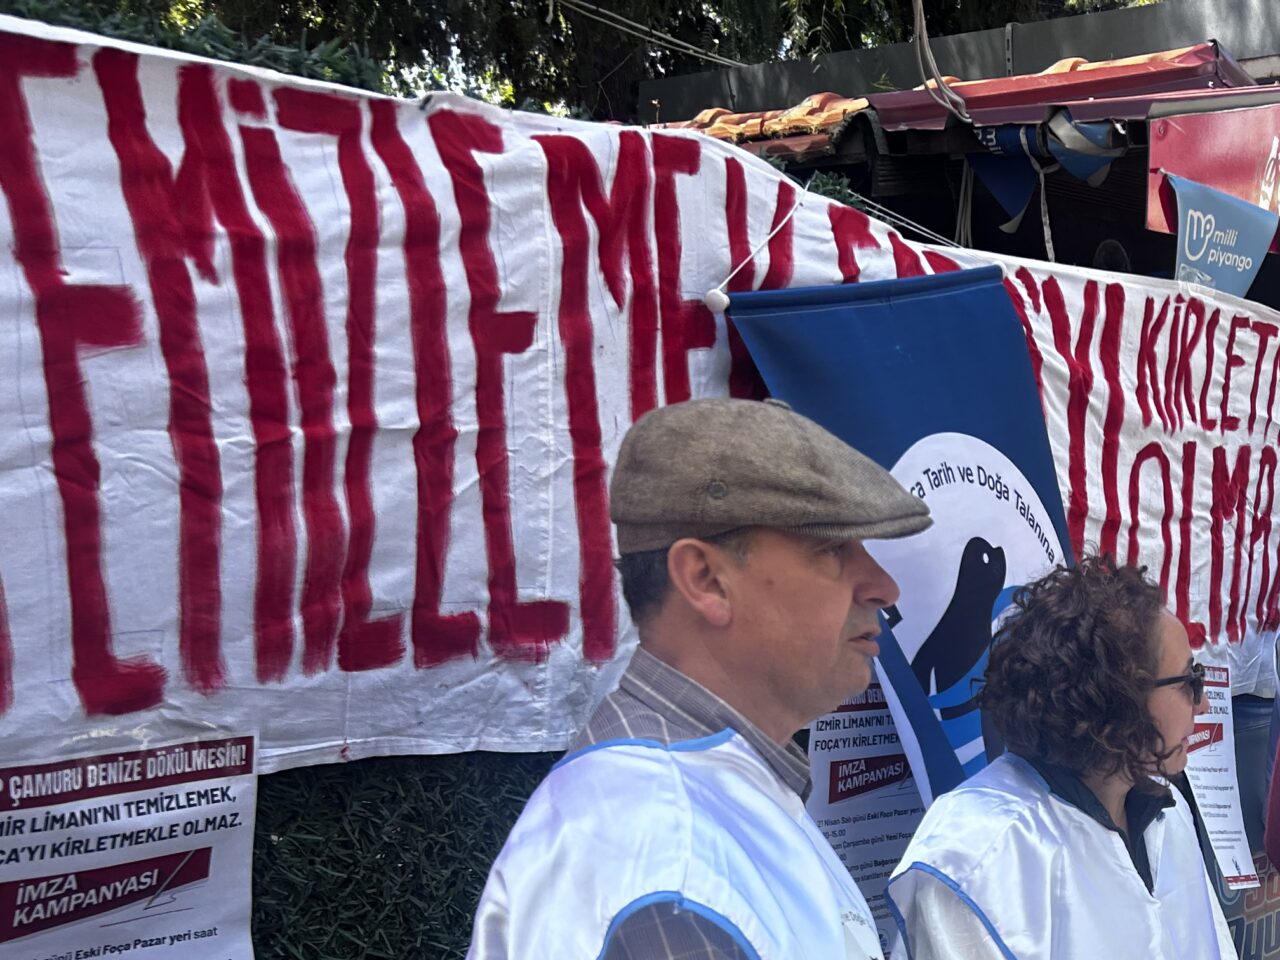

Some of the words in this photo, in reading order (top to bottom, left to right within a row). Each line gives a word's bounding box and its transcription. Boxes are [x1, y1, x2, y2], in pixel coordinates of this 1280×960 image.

[1213, 229, 1238, 246] milli
[1207, 246, 1253, 272] piyango
[923, 462, 956, 491] Tarih
[958, 465, 974, 484] ve
[976, 465, 1010, 501] Doğa
[1013, 489, 1055, 563] Talanına
[816, 716, 841, 733] İZMİR
[814, 737, 851, 753] FOÇA'YI
[852, 733, 900, 749] KİRLETMEK
[9, 767, 83, 807] ÇAMURU
[86, 756, 142, 788] DENİZE
[146, 744, 247, 780] DÖKÜLMESİN!
[838, 759, 866, 778] İMZA
[838, 761, 904, 793] KAMPANYASI
[30, 802, 121, 834] LİMANI'NI
[124, 785, 237, 818] TEMİZLEMEK,
[50, 823, 180, 859] KİRLETMEKLE
[183, 812, 242, 837] OLMAZ.
[12, 868, 159, 928] KAMPANYASI
[16, 873, 78, 906] İMZA
[75, 944, 102, 960] Eski
[102, 940, 131, 959] Foça
[133, 936, 167, 951] Pazar
[169, 929, 192, 947] yeri
[193, 926, 219, 940] saat
